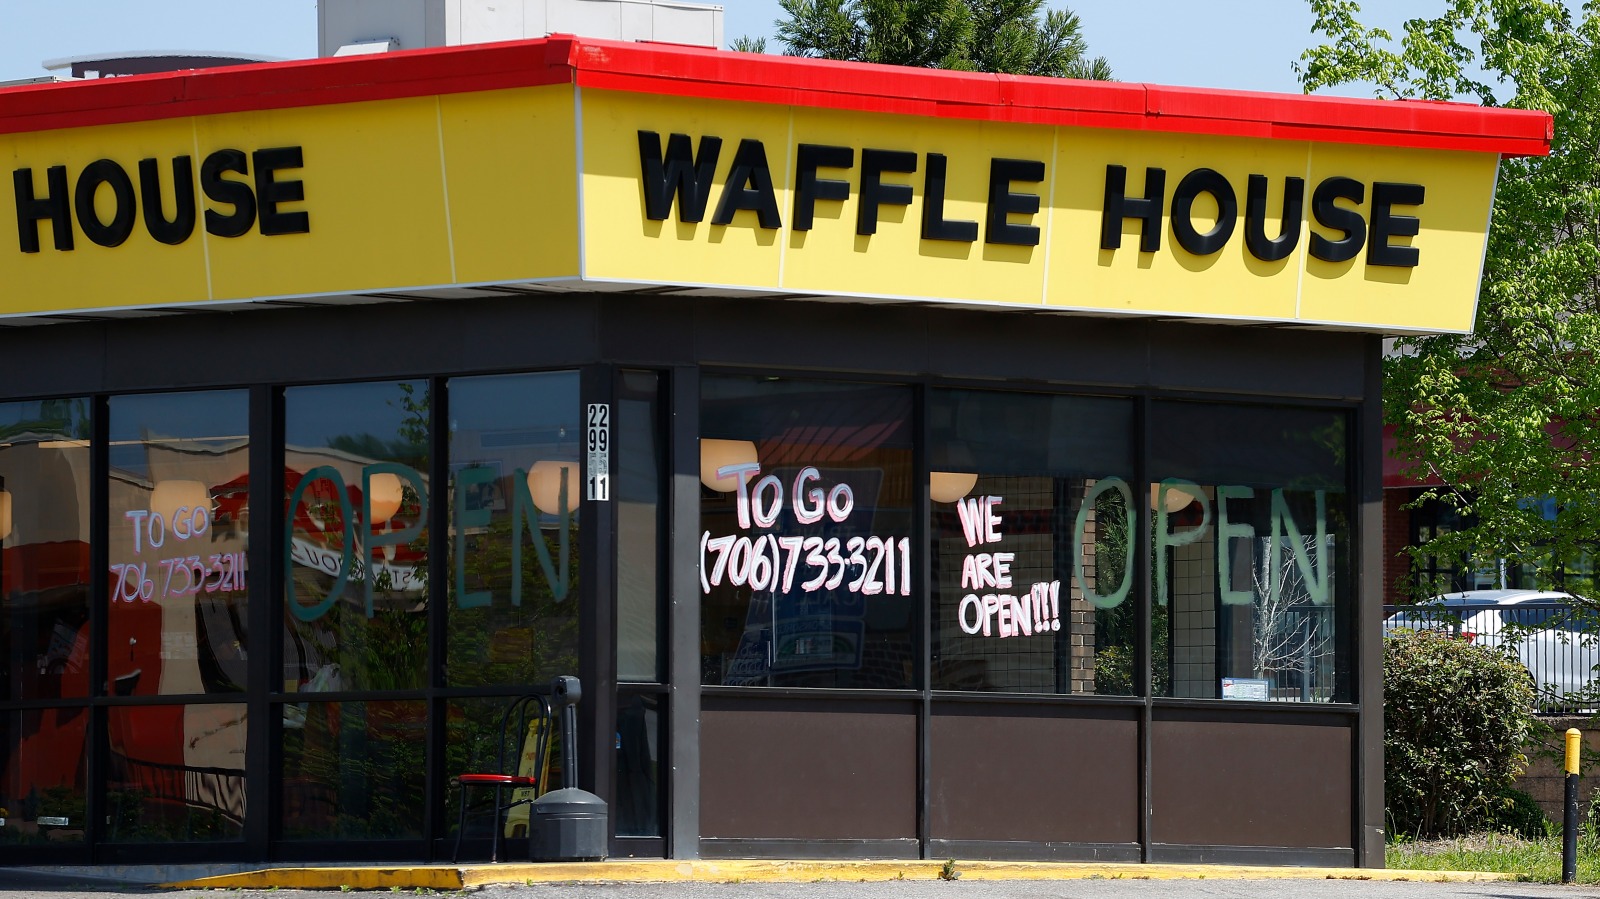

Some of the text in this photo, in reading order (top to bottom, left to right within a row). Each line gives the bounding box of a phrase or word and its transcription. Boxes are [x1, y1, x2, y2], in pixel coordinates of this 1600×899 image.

[12, 145, 310, 253] HOUSE
[637, 129, 1426, 268] WAFFLE HOUSE
[125, 505, 209, 556] TO GO
[285, 461, 570, 622] OPEN
[956, 494, 1003, 548] WE
[1073, 474, 1329, 609] OPEN
[110, 550, 246, 603] 706 733-3211
[961, 552, 1016, 591] ARE
[958, 579, 1061, 639] OPEN!!!
